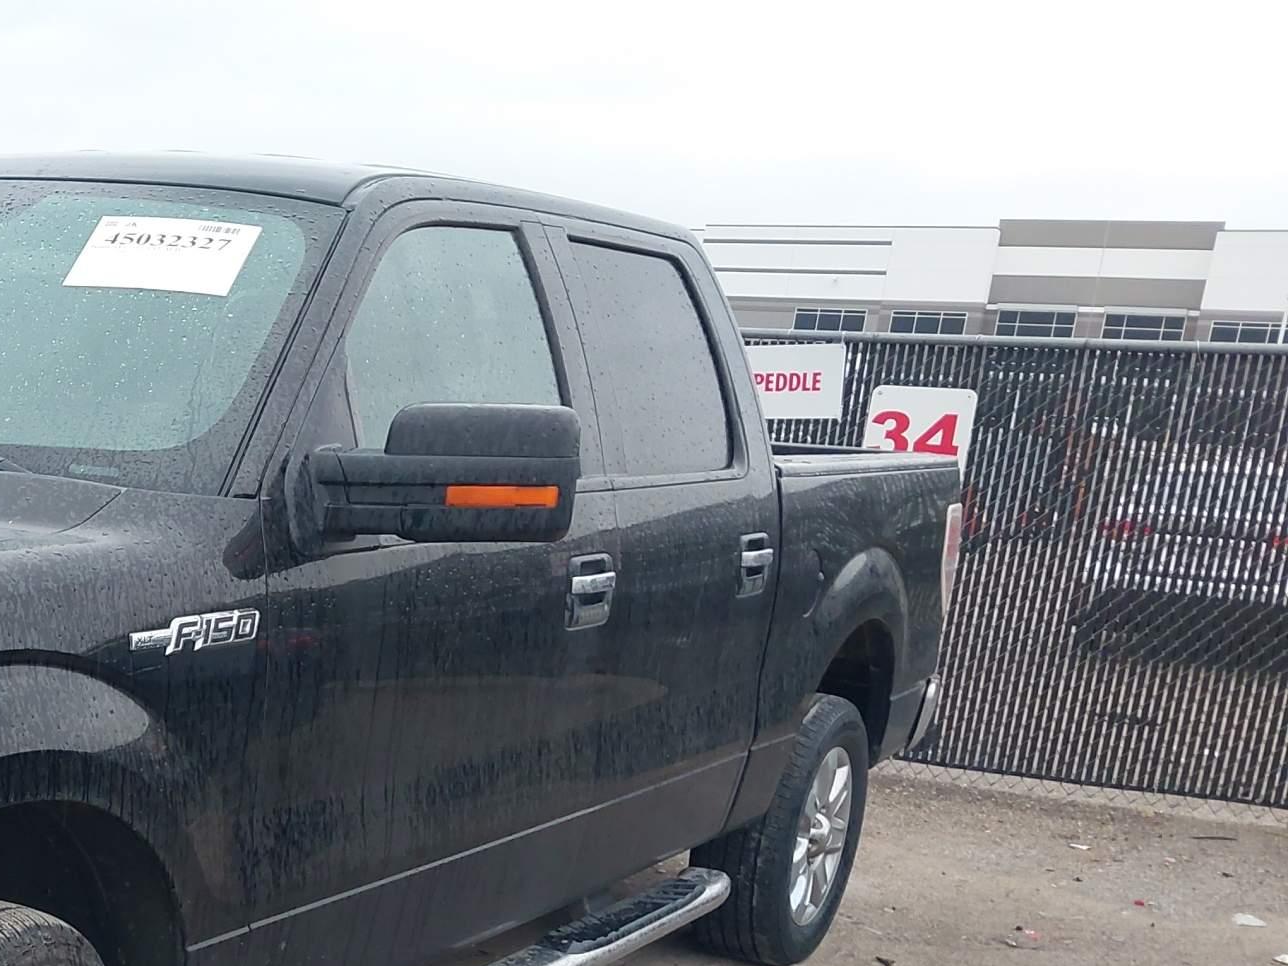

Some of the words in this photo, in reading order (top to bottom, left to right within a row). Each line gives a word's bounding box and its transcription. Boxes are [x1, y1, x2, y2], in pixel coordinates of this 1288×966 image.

[105, 232, 232, 251] 45032327
[755, 372, 822, 392] PEDDLE
[871, 410, 959, 457] 34
